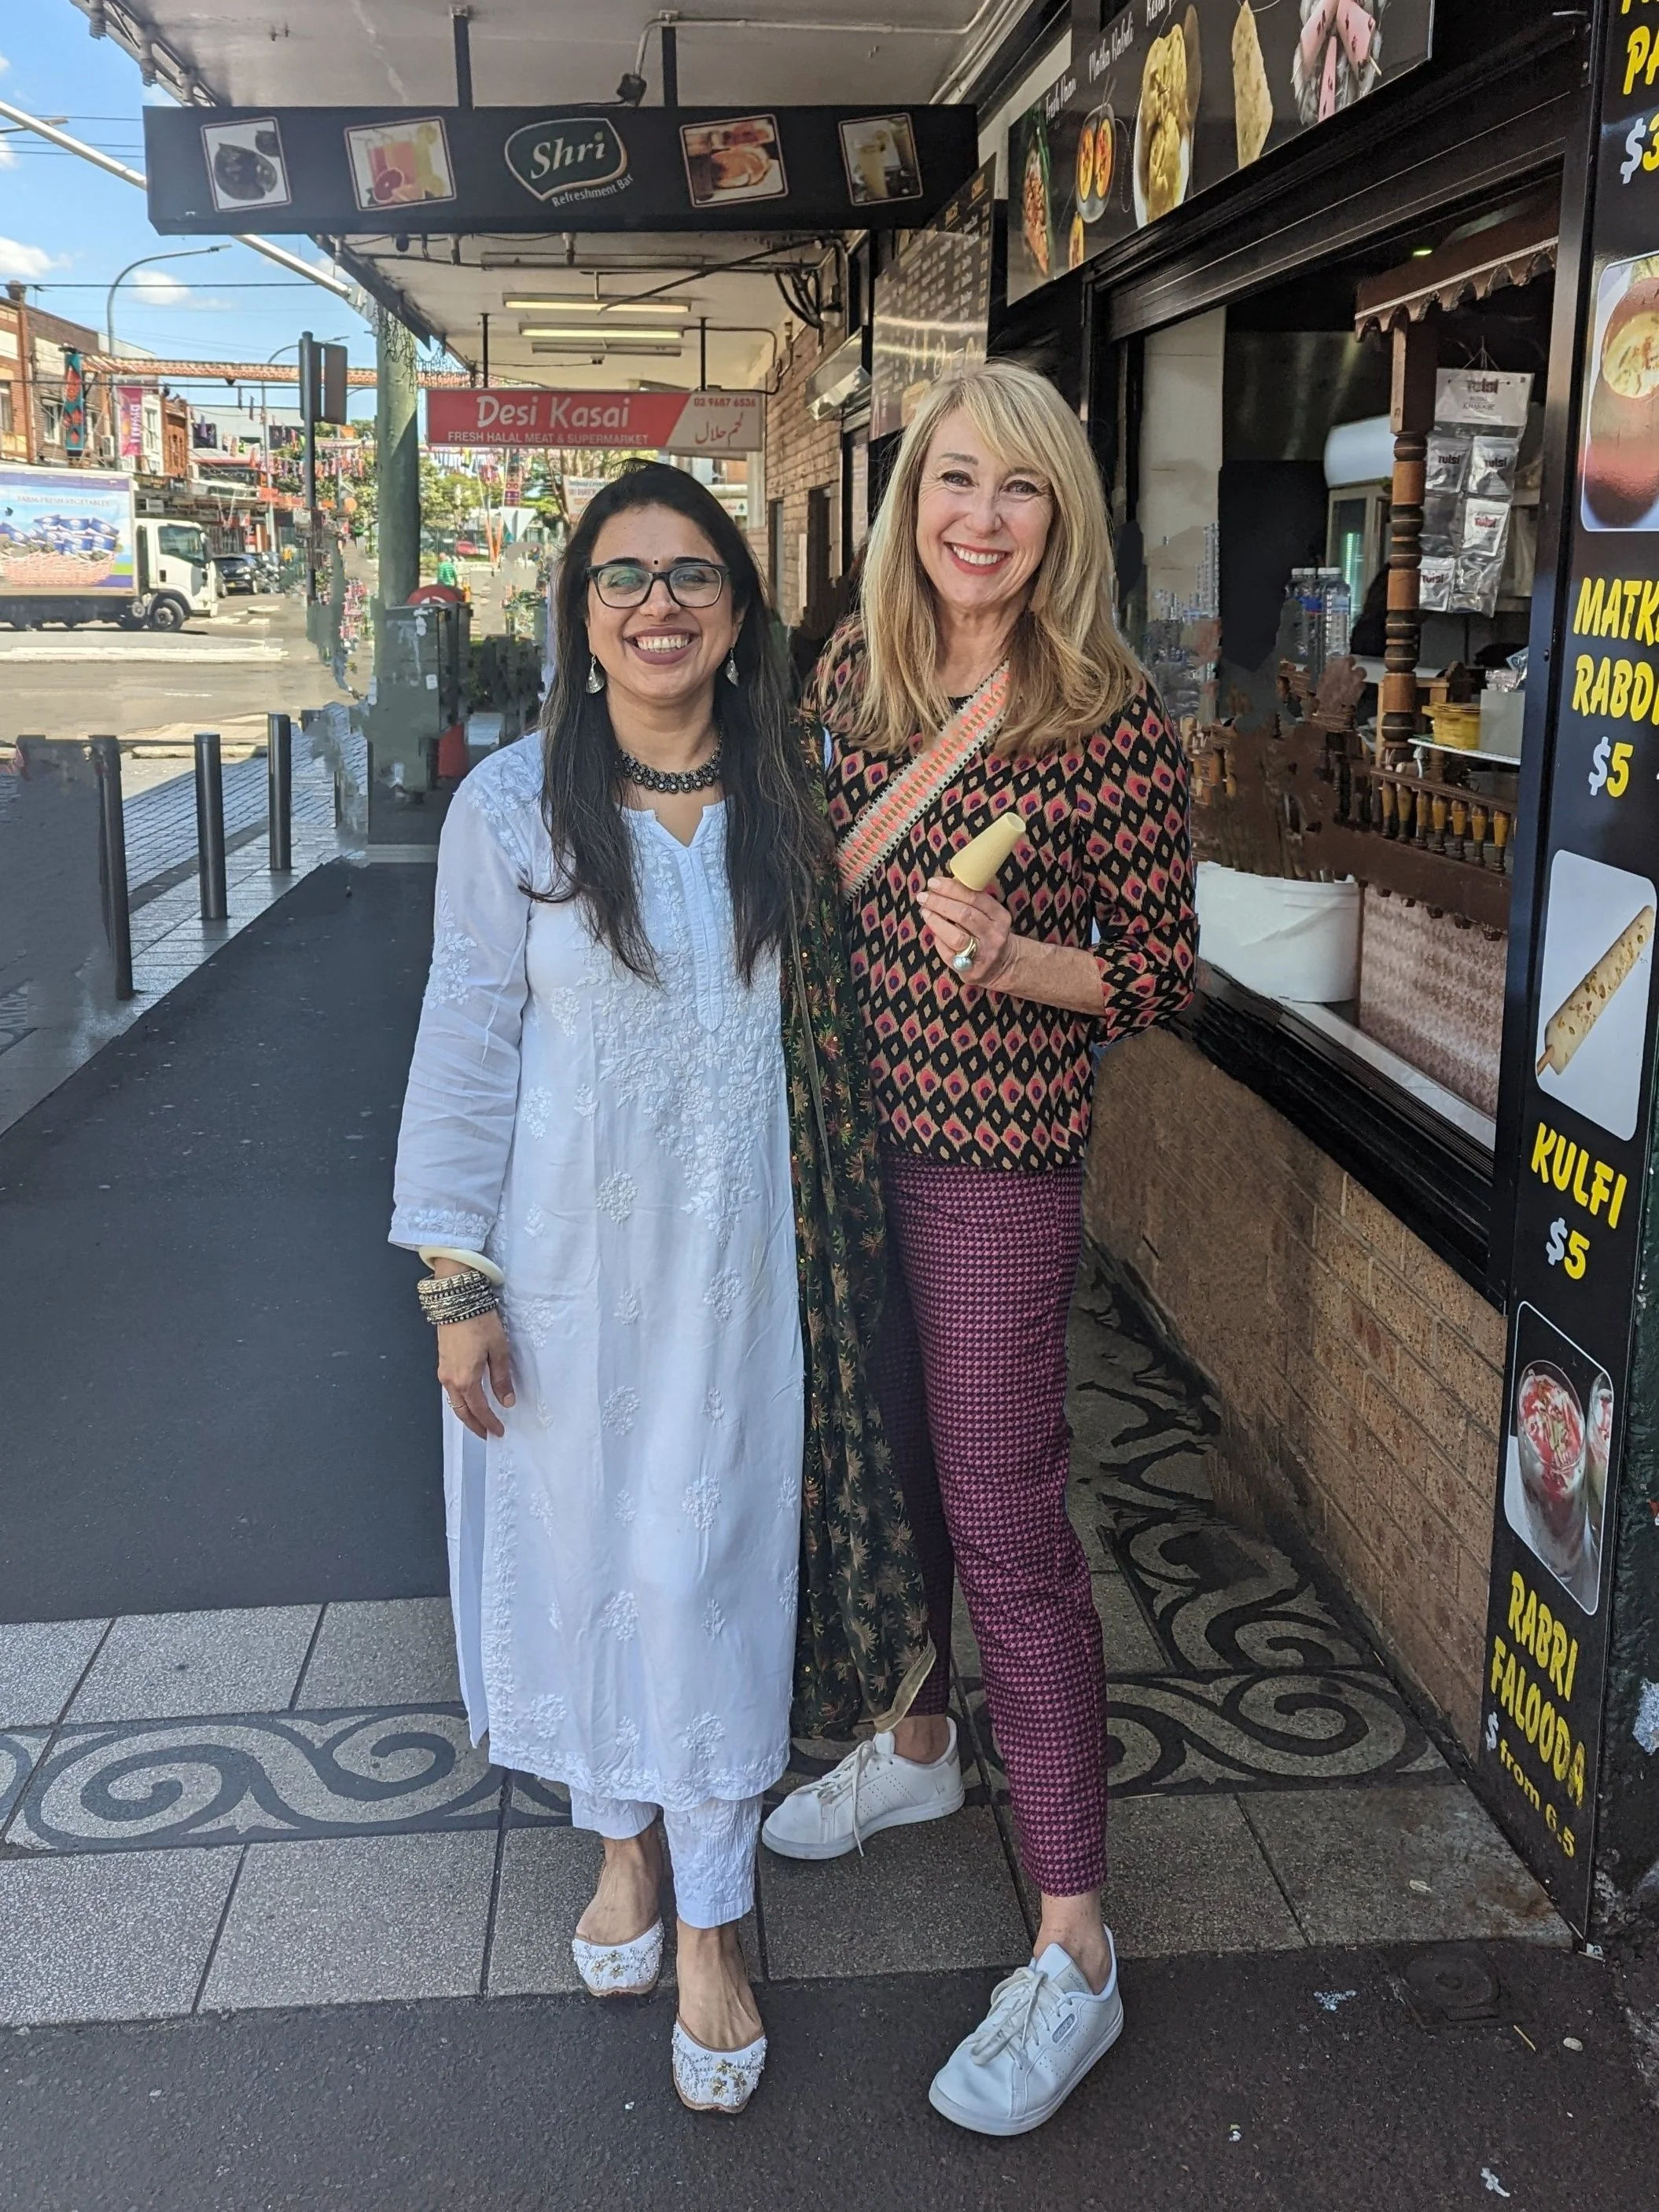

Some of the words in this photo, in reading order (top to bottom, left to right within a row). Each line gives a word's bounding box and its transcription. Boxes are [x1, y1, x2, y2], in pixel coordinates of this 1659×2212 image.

[530, 131, 605, 179] Shri
[551, 183, 617, 208] Refreshment
[617, 173, 634, 189] Bar
[476, 395, 539, 428] Desi
[549, 396, 631, 428] Kasai
[693, 398, 705, 407] 02
[708, 398, 731, 407] 9687
[734, 398, 756, 407] 6536
[448, 432, 484, 443] FRESH
[487, 432, 523, 443] HALAL
[524, 433, 554, 443] MEAT
[557, 434, 564, 444] &
[568, 434, 649, 445] SUPERMARKET
[694, 421, 727, 446] حلال
[65, 498, 110, 506] VEGETABLES
[1573, 577, 1659, 646] MATK
[1588, 737, 1634, 798] $5
[1531, 1122, 1628, 1229] KULFI
[1545, 1218, 1590, 1280] $5
[1508, 1571, 1578, 1702] RABRI
[1491, 1635, 1585, 1807] FALOODA
[1500, 1739, 1540, 1811] from
